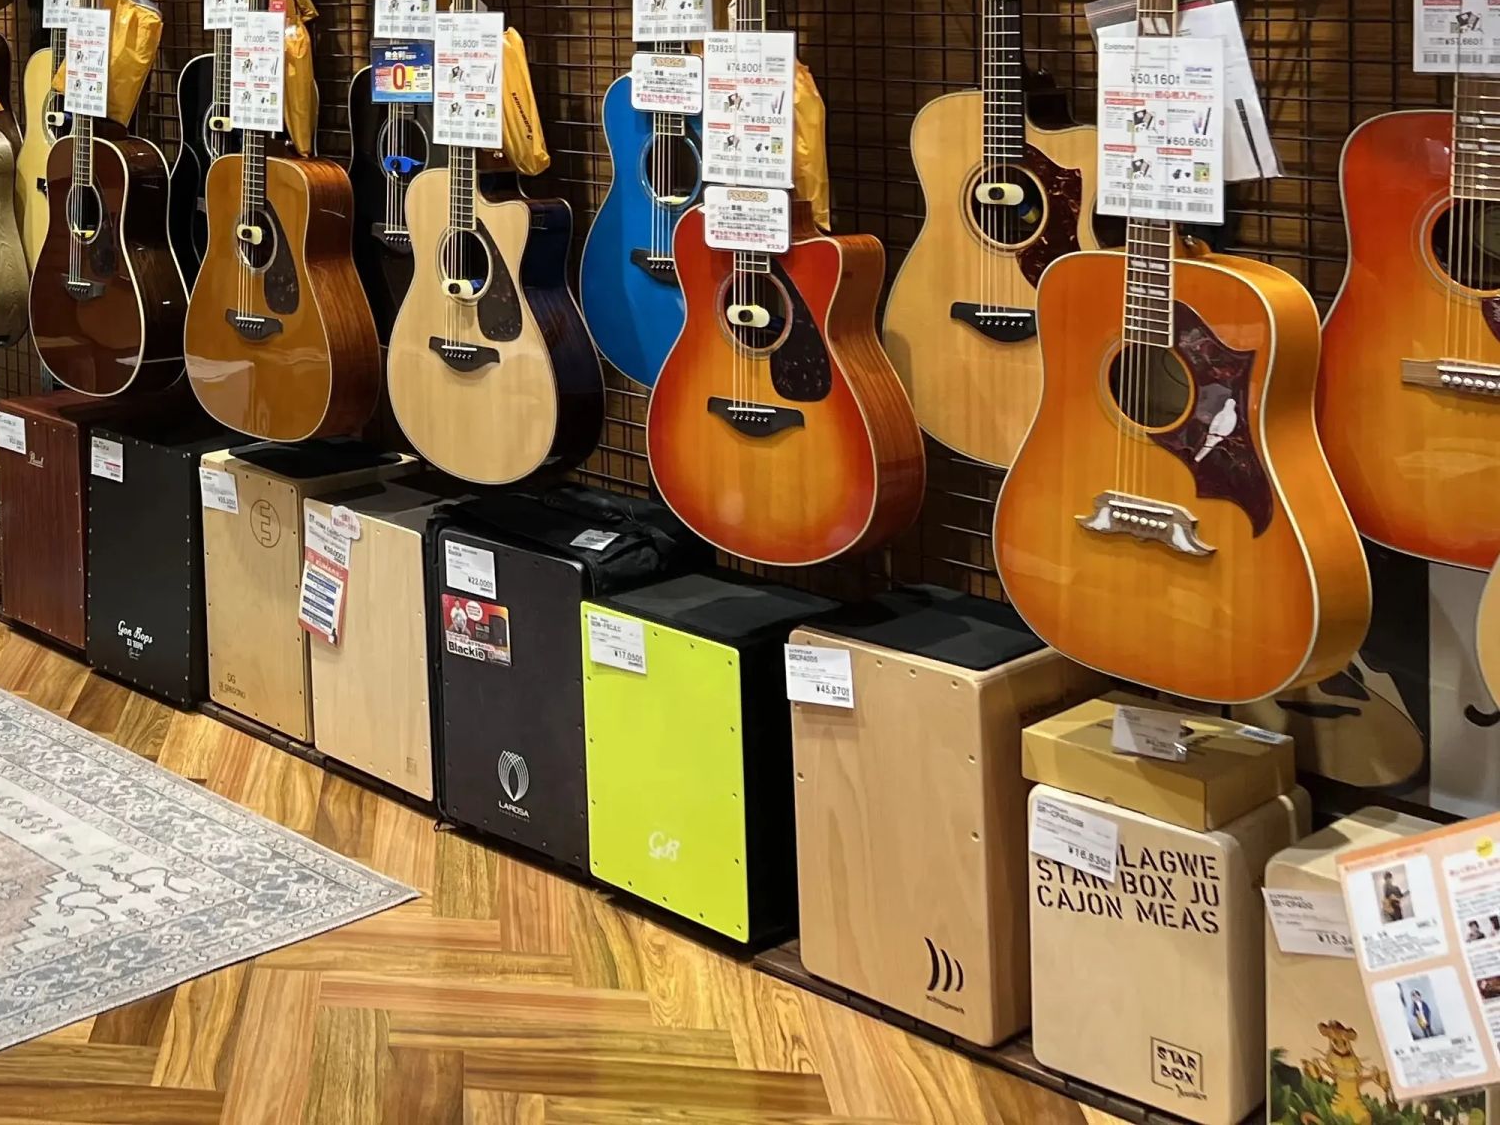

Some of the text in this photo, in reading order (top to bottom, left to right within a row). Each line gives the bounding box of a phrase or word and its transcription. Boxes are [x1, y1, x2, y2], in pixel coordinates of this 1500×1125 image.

[448, 640, 485, 661] Blackie
[498, 800, 530, 818] LAROSA
[1119, 870, 1178, 903] BOX
[1191, 881, 1220, 907] JU
[1036, 884, 1220, 935] CAJON MEAS
[1157, 1046, 1197, 1071] STAR
[1160, 1064, 1195, 1085] BOX
